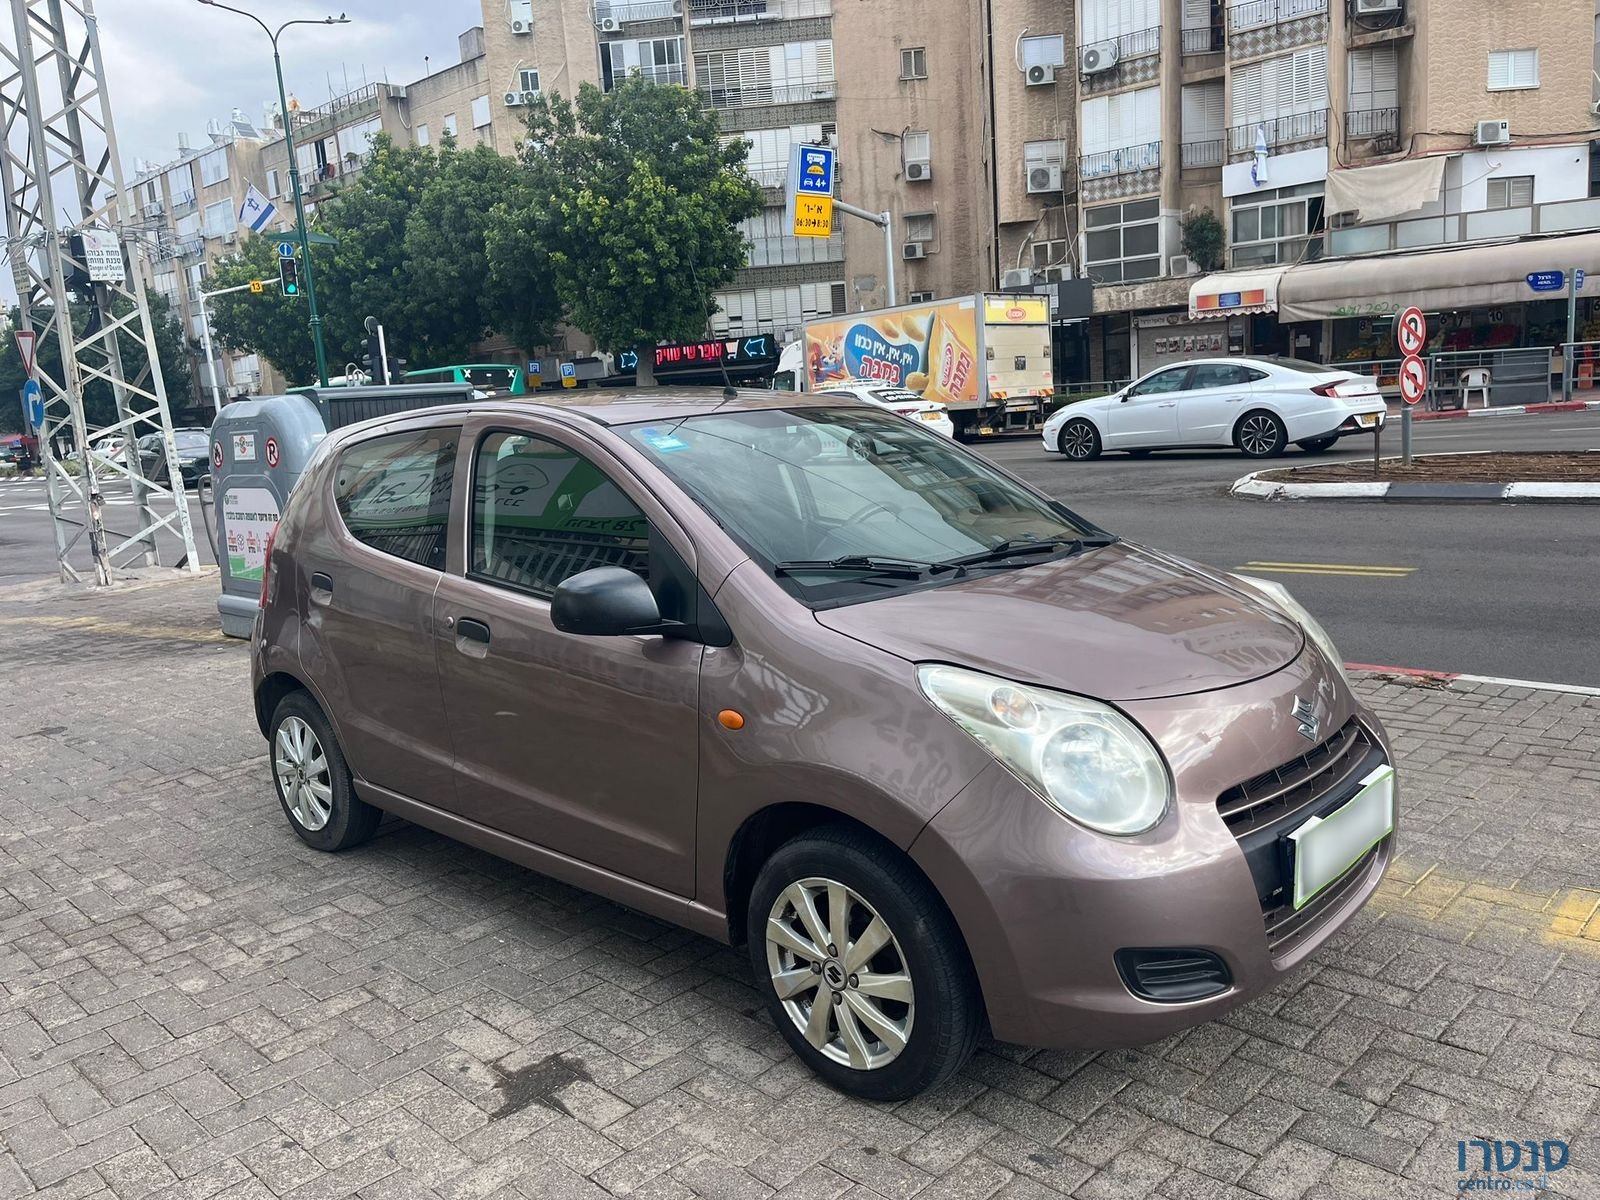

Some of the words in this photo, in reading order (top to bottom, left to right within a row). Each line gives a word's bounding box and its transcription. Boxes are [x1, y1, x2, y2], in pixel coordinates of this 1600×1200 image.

[815, 178, 827, 188] 4+
[251, 282, 261, 291] 13
[855, 333, 872, 349] כמו
[860, 354, 900, 384] במבה
[949, 350, 971, 399] במבה
